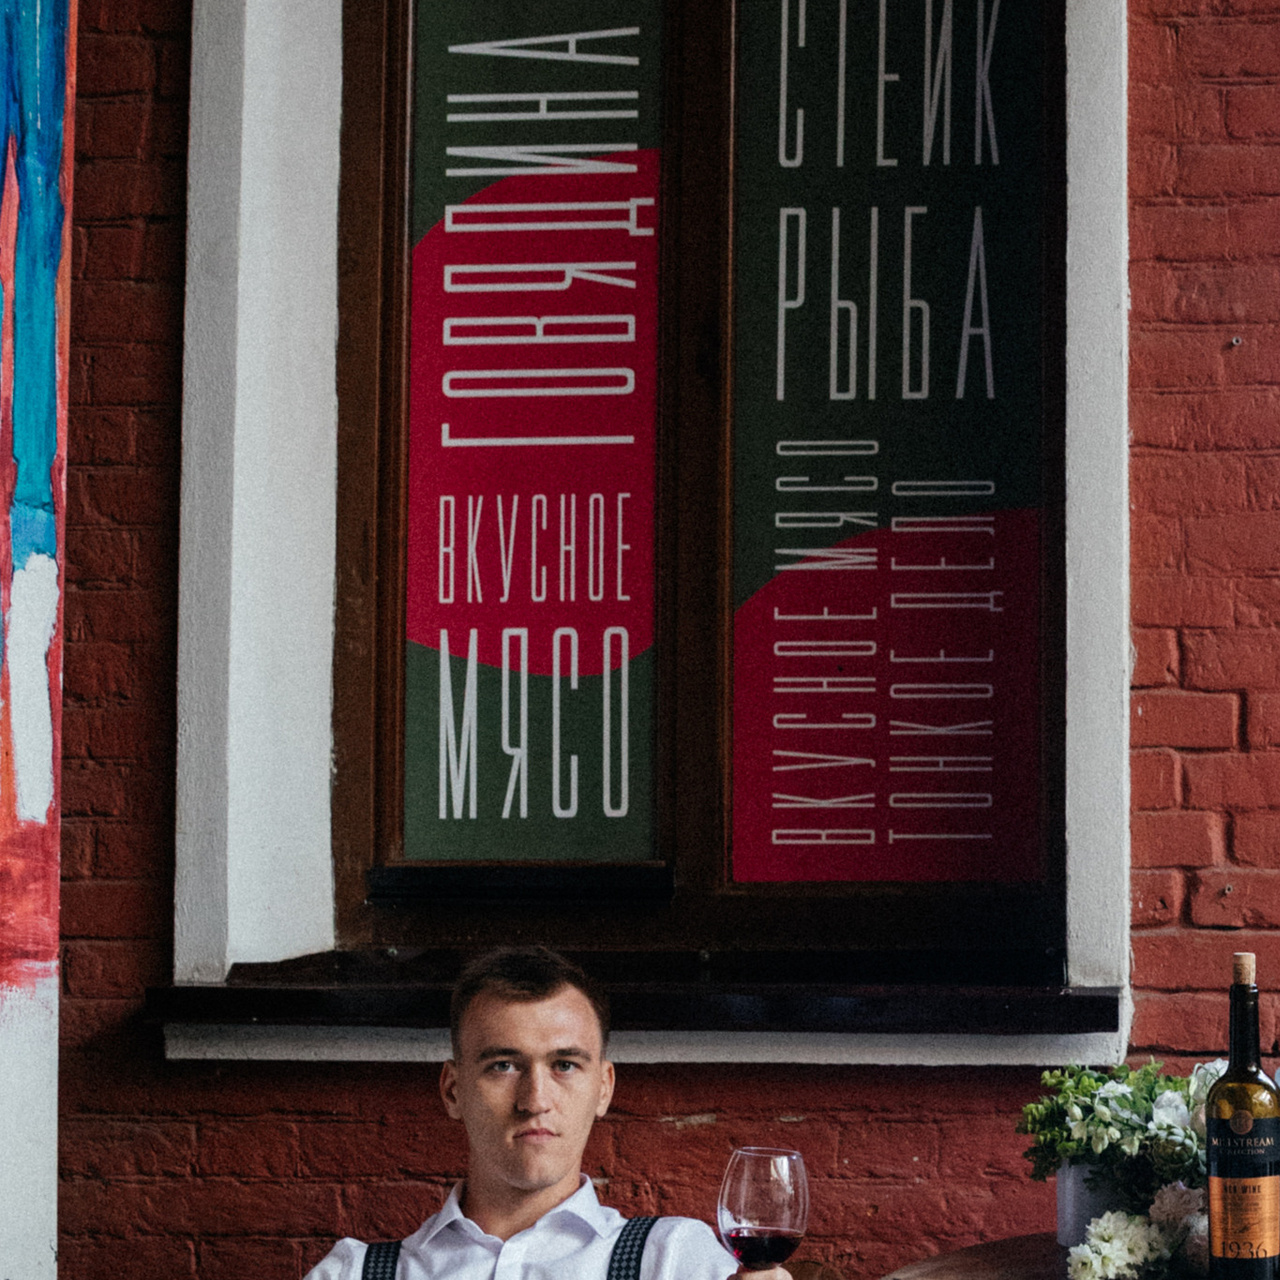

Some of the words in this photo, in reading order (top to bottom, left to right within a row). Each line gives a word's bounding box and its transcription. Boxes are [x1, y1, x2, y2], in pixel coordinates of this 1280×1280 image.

[440, 26, 656, 448] ГОВЯДИНА
[776, 206, 997, 402] РЫБА
[438, 492, 632, 605] ВКУСНОЕ
[775, 439, 880, 572] МЯСО
[889, 479, 1004, 610] ДЕЛО
[438, 625, 630, 821] МЯСО
[771, 607, 879, 846] ВКУСНОЕ
[888, 648, 994, 844] ТОНКОЕ
